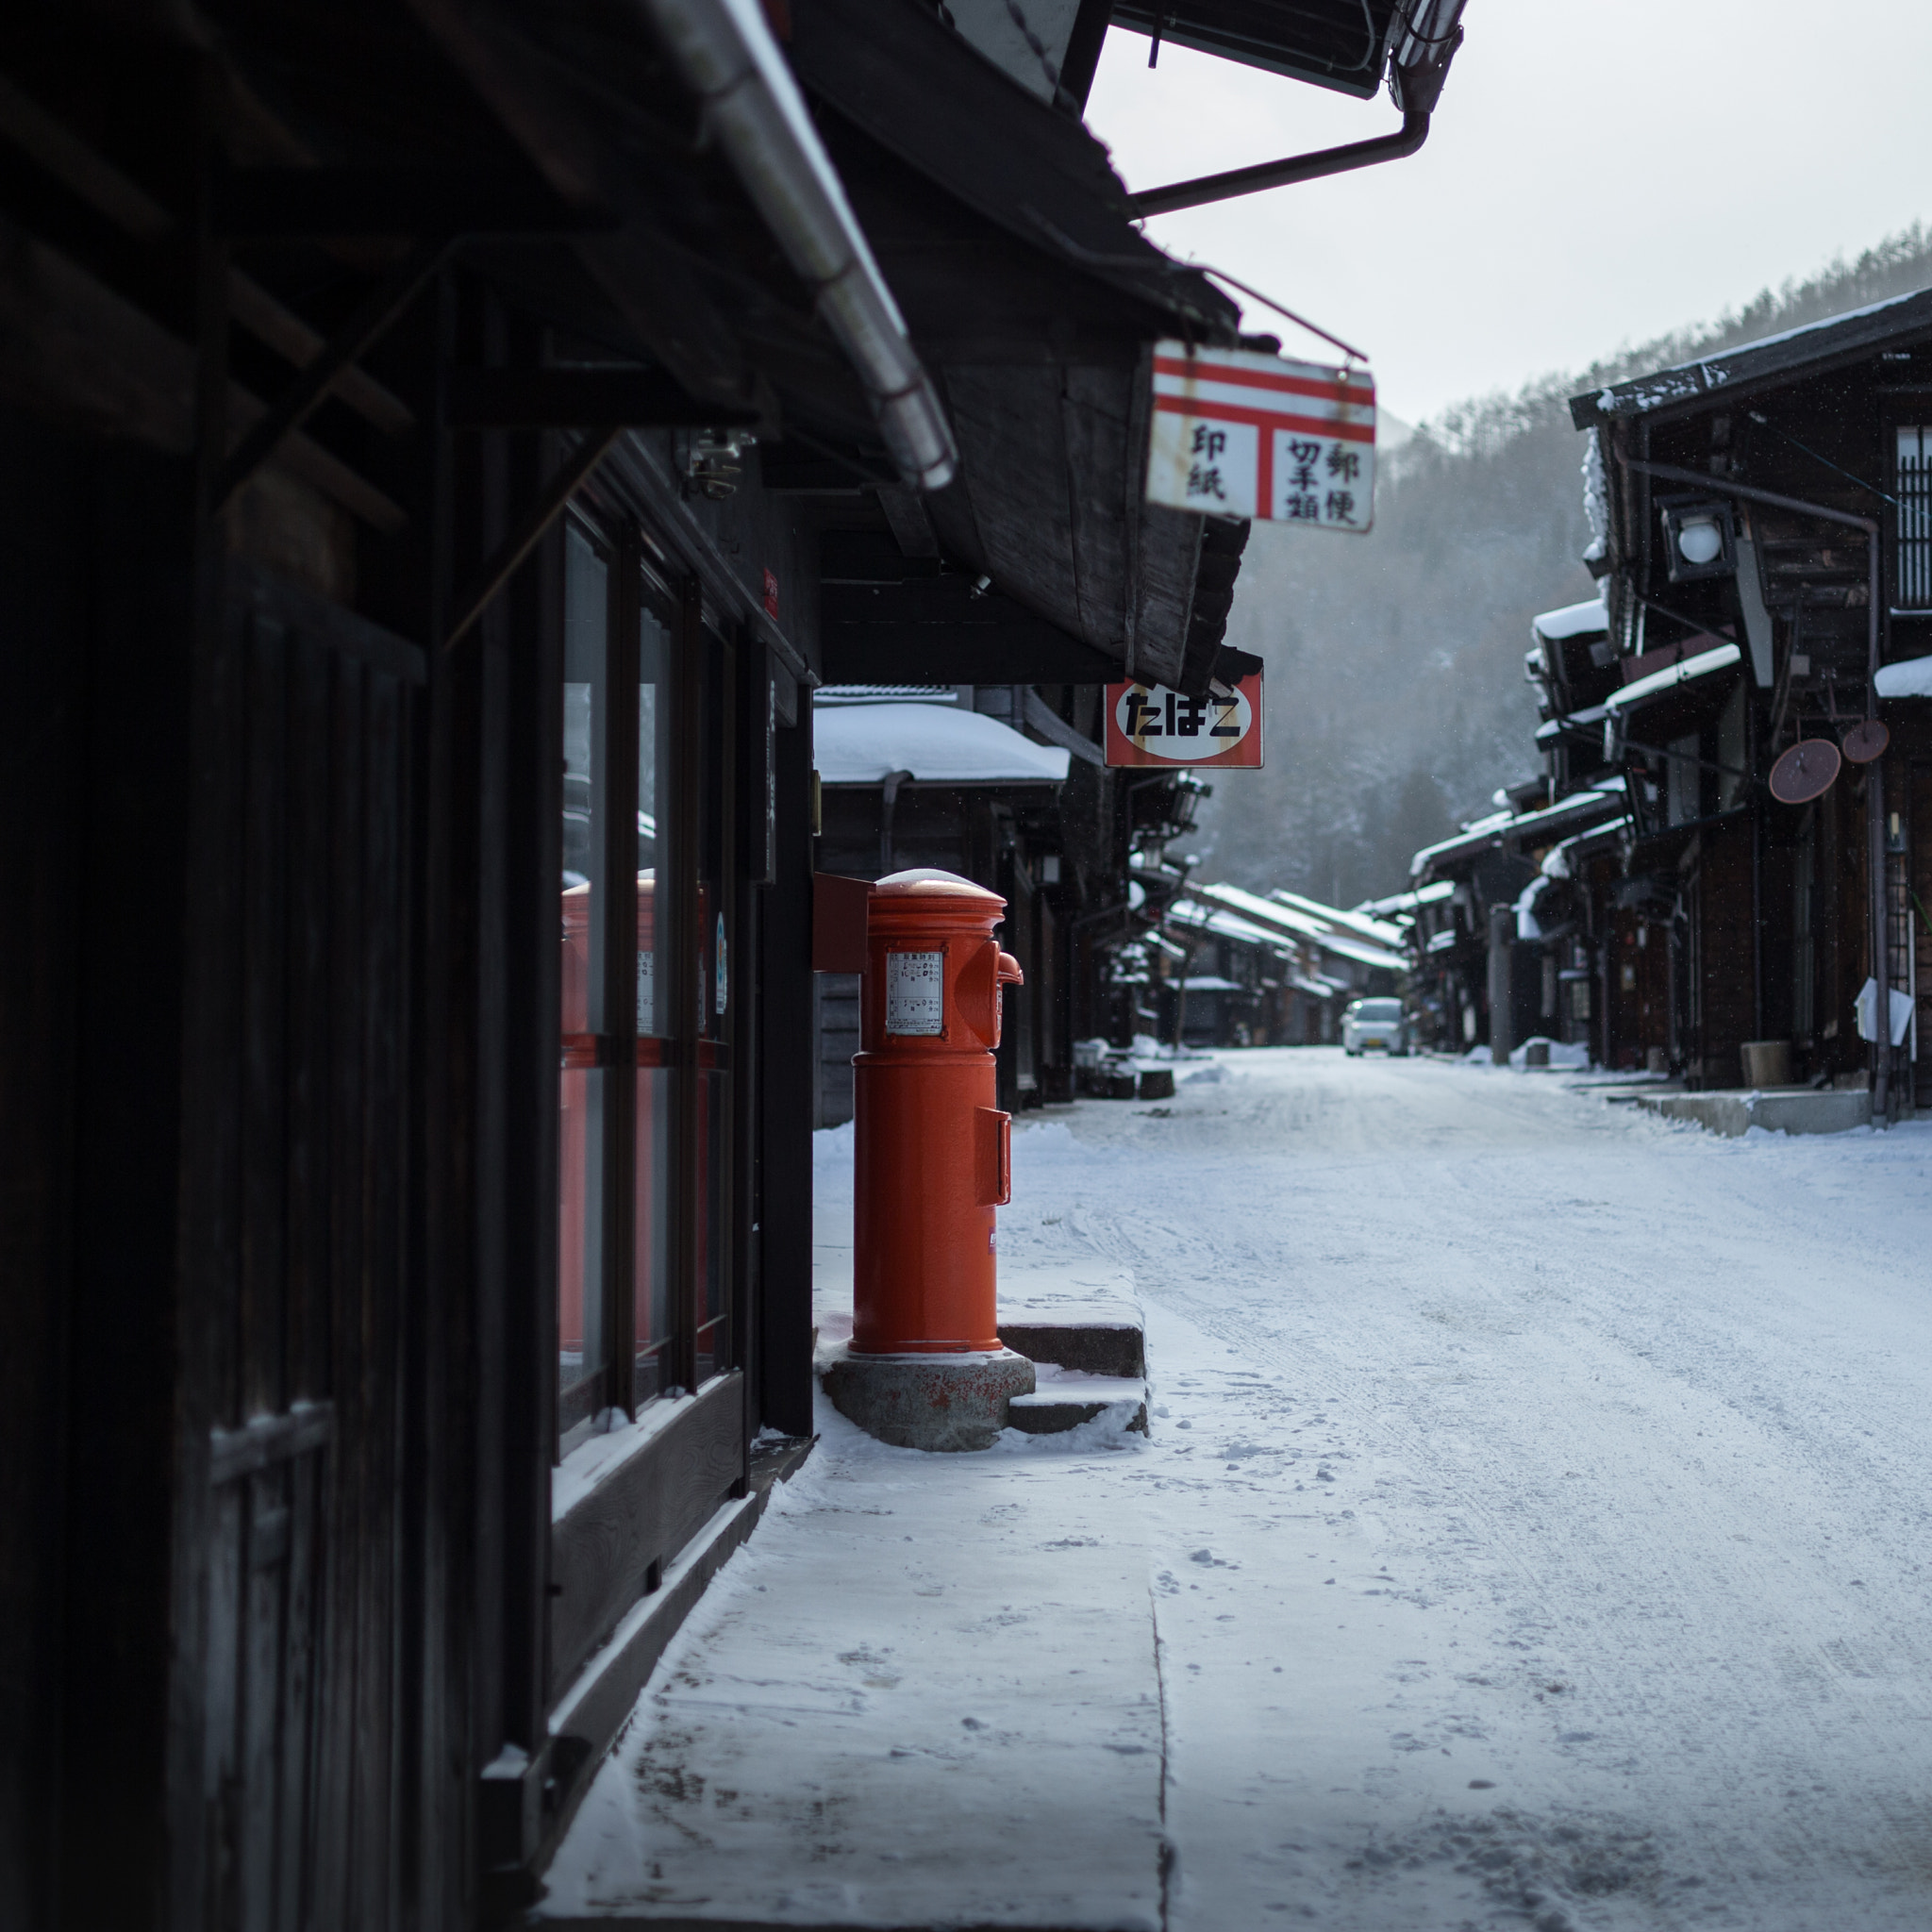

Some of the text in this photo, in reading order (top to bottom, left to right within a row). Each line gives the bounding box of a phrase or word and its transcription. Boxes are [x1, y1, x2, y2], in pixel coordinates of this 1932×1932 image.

[1187, 424, 1226, 501] 印紙
[1286, 437, 1322, 520] 切手類
[1325, 441, 1360, 525] 郵便
[1125, 692, 1241, 737] たばこ
